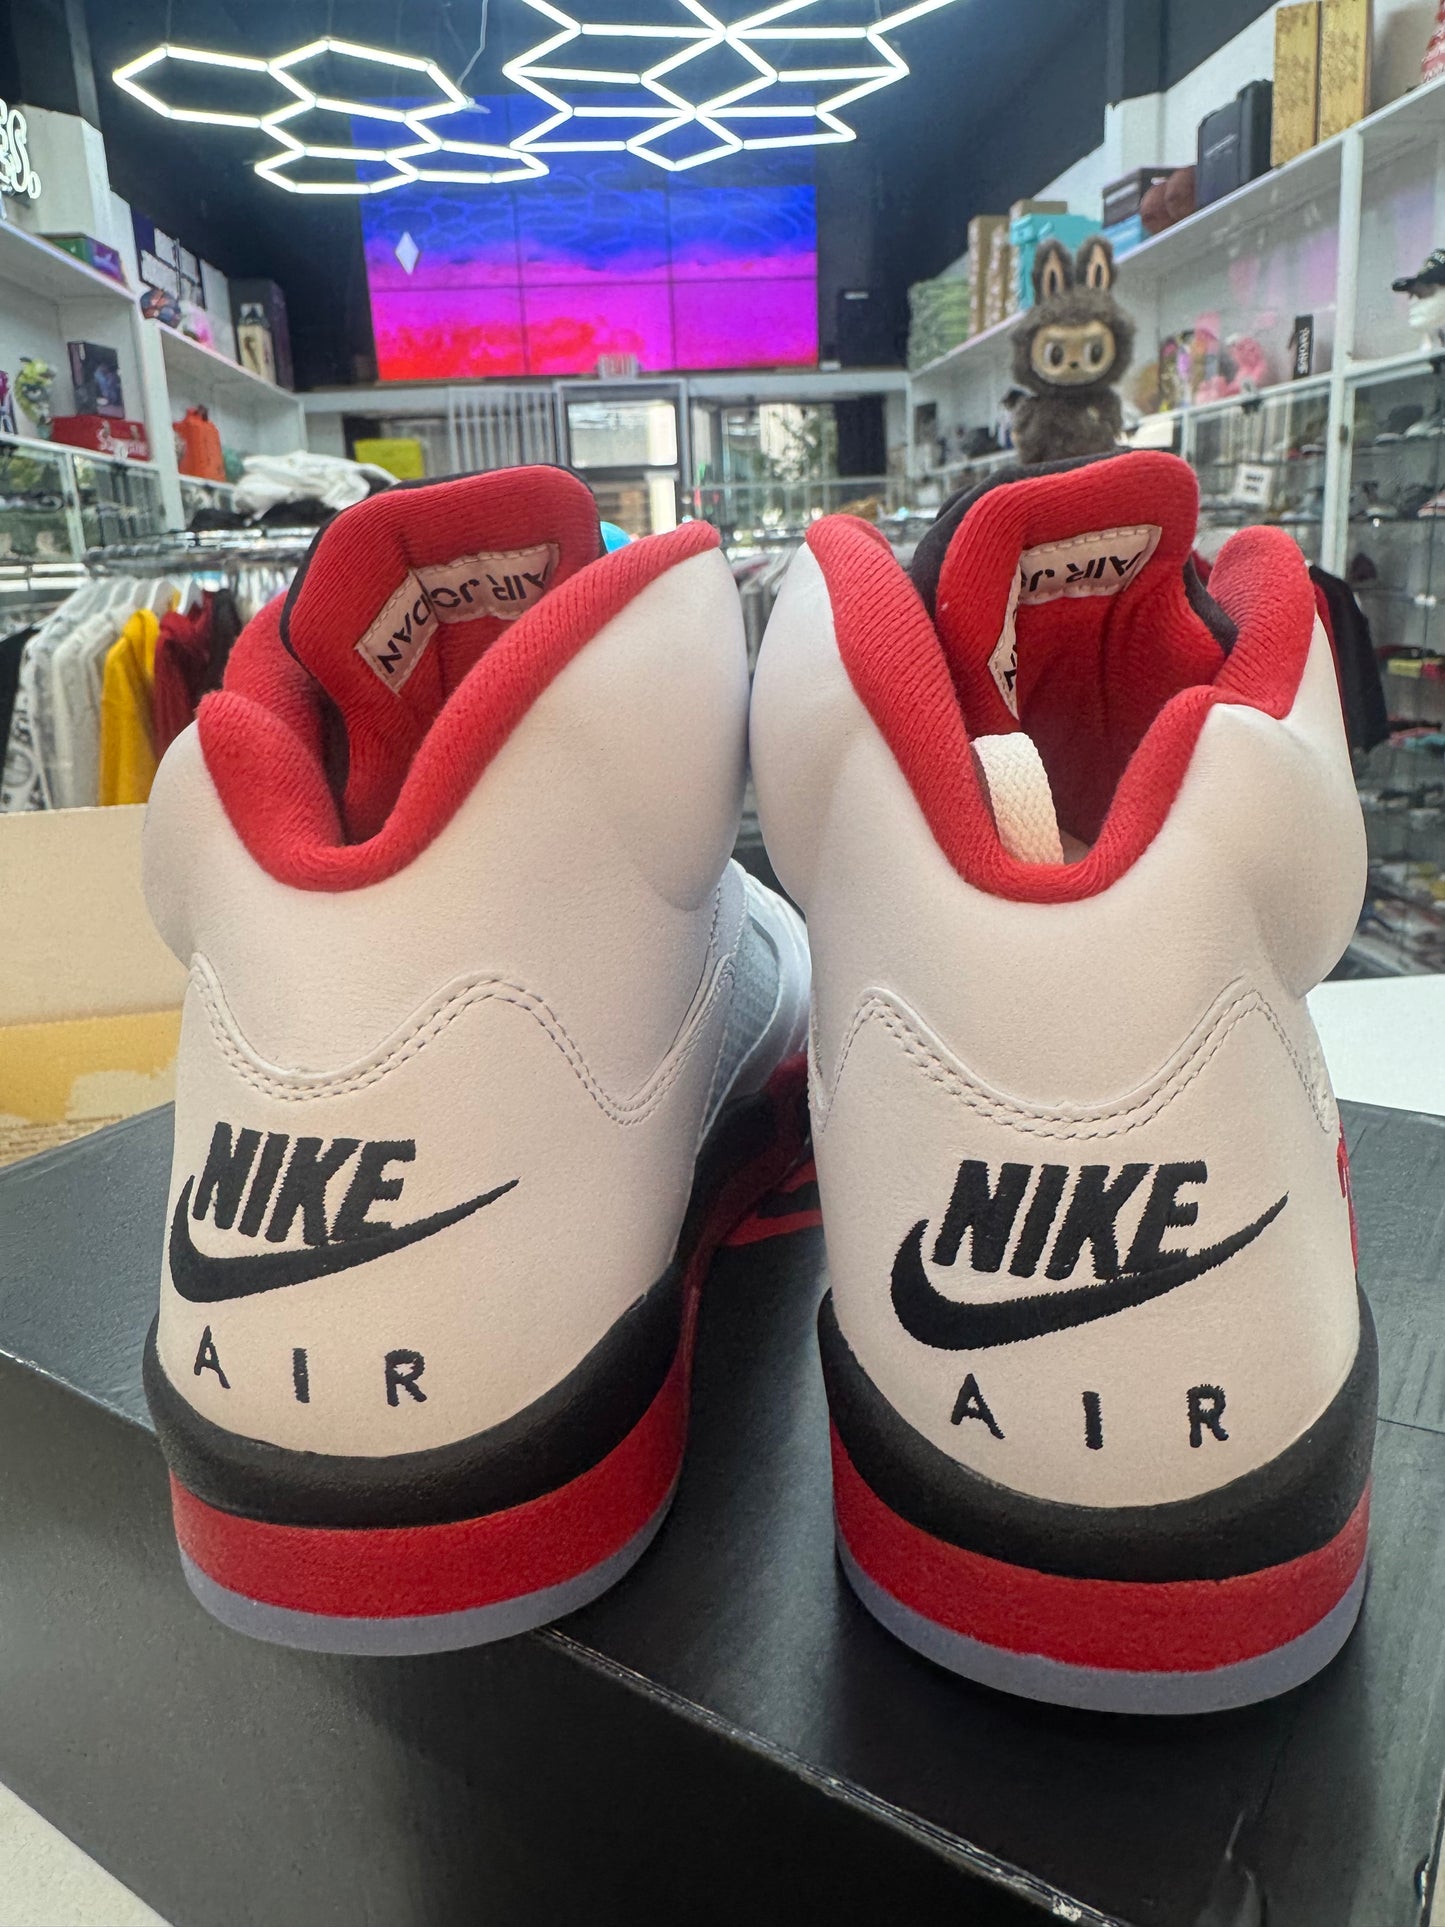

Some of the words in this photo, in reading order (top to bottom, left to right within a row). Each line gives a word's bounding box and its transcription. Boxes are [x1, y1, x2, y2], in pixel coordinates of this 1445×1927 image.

[486, 561, 551, 601] AIR
[1066, 551, 1143, 583] AIR
[376, 579, 480, 674] JODAN
[192, 1122, 416, 1246] NIKE
[932, 1160, 1208, 1281] NIKE
[194, 1325, 428, 1406] AIR
[950, 1373, 1229, 1450] AIR
